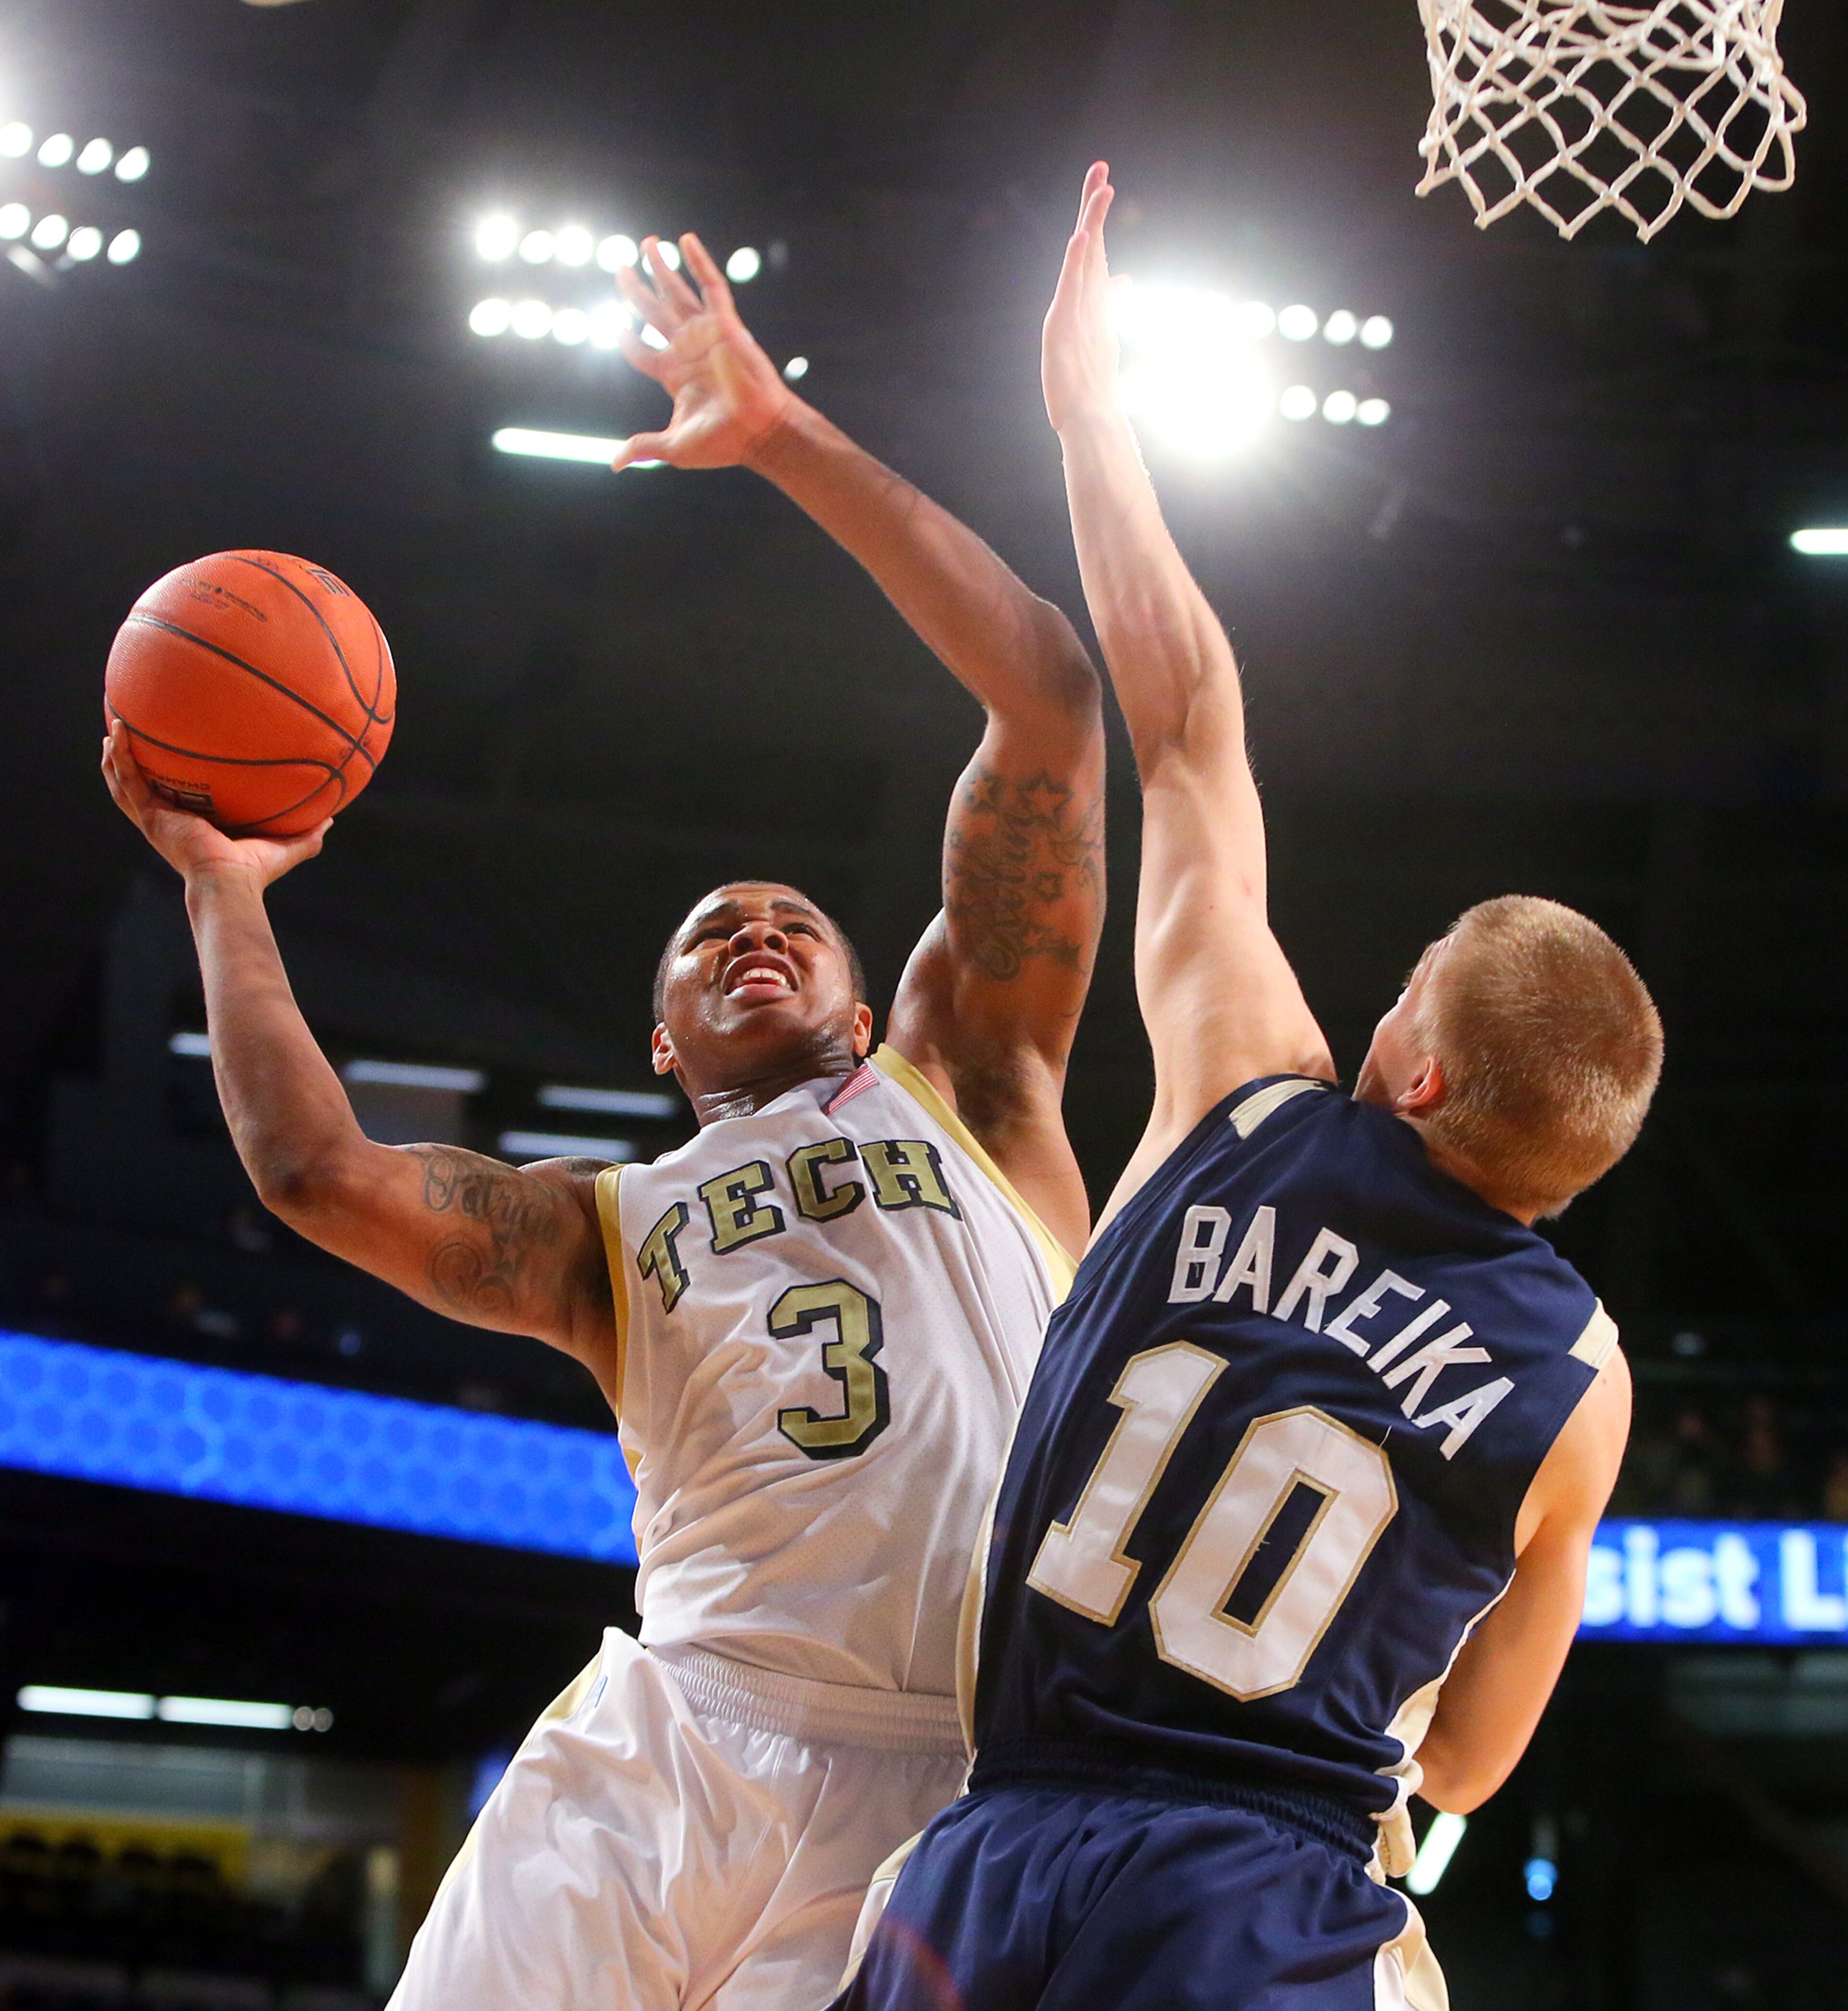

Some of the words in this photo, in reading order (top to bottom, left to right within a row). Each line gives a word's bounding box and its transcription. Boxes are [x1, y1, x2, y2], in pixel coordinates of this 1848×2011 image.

[143, 767, 210, 791] CHAMPIO
[637, 1137, 963, 1315] TECH
[767, 1277, 890, 1460] 3
[1167, 1204, 1515, 1461] BAREIKA
[1026, 1340, 1399, 1702] 10
[1780, 1528, 1848, 1632] L
